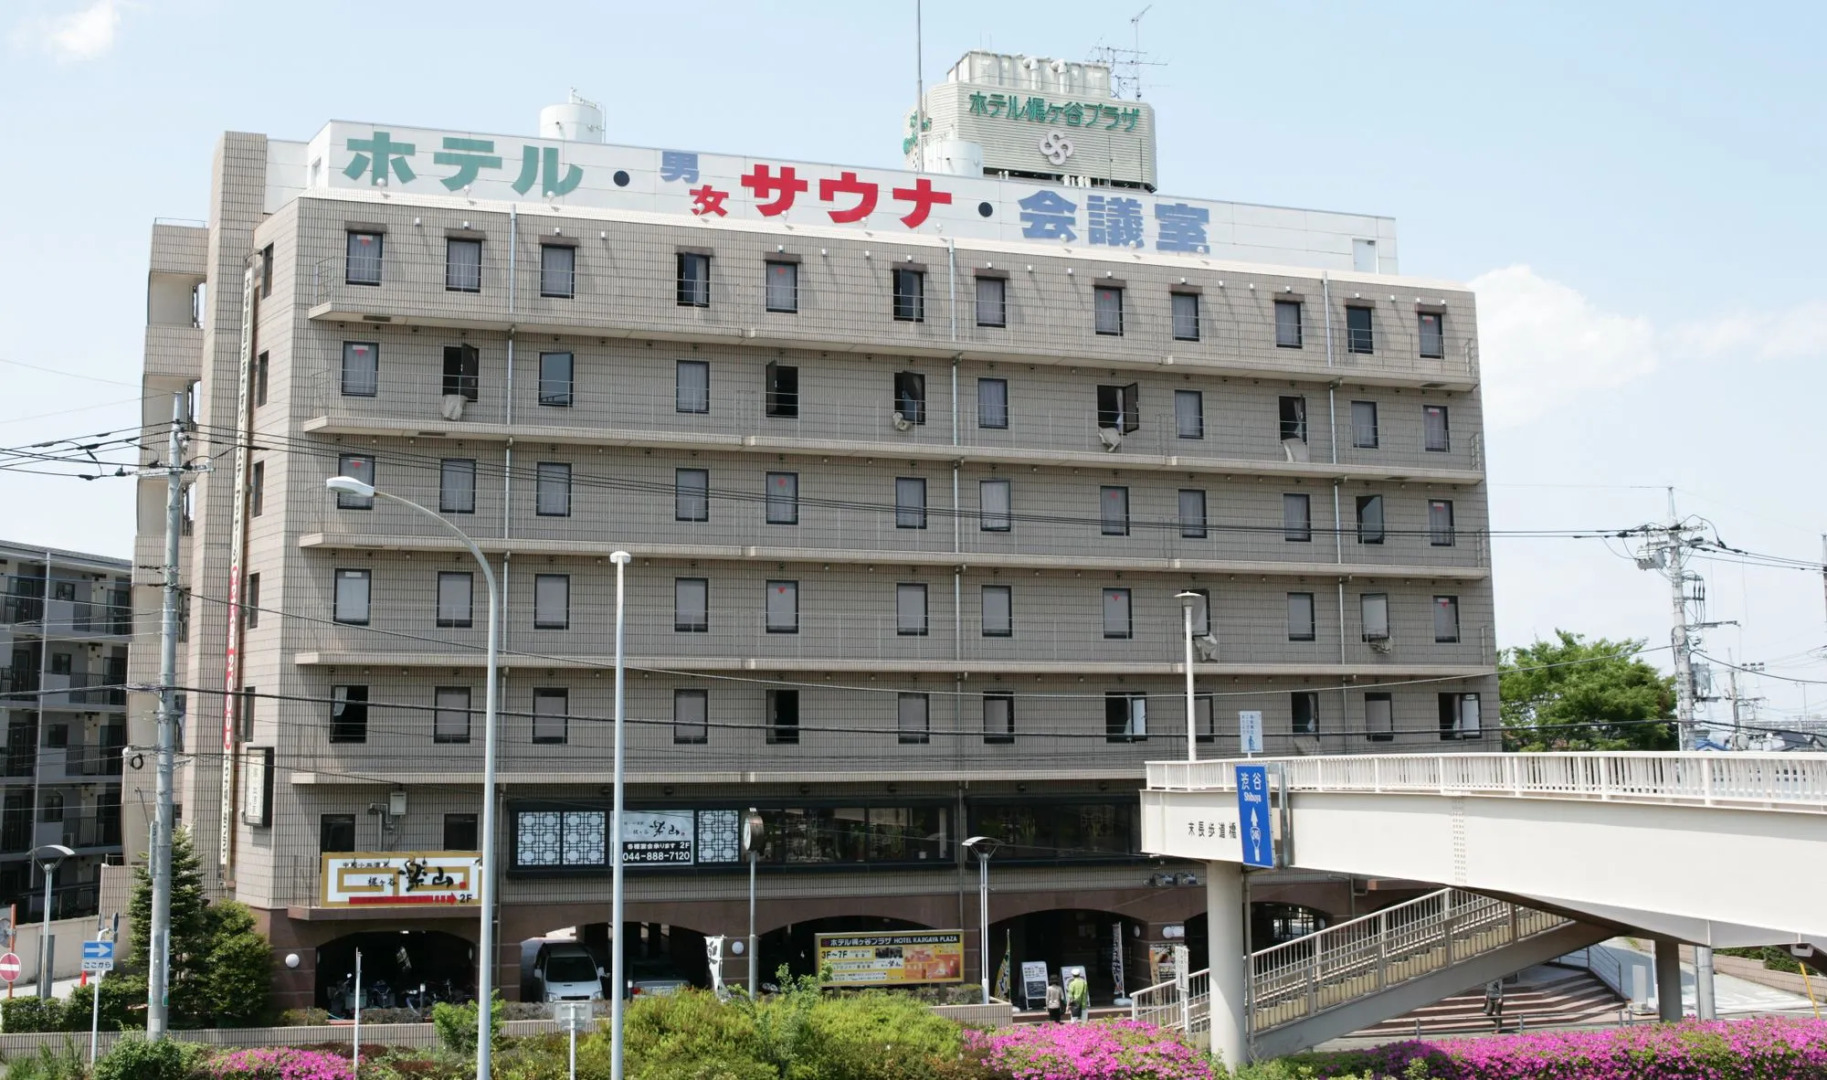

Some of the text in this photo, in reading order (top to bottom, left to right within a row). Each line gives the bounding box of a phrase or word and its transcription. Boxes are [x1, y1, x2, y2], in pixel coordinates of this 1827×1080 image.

[342, 131, 584, 199] ホテル
[741, 163, 952, 229] サウナ
[1017, 190, 1211, 255] 会議室
[1240, 772, 1262, 790] 渋谷
[622, 852, 690, 861] 044-888-7120
[459, 894, 472, 903] 2F
[939, 935, 958, 943] PLAZA
[84, 961, 111, 969] ここから
